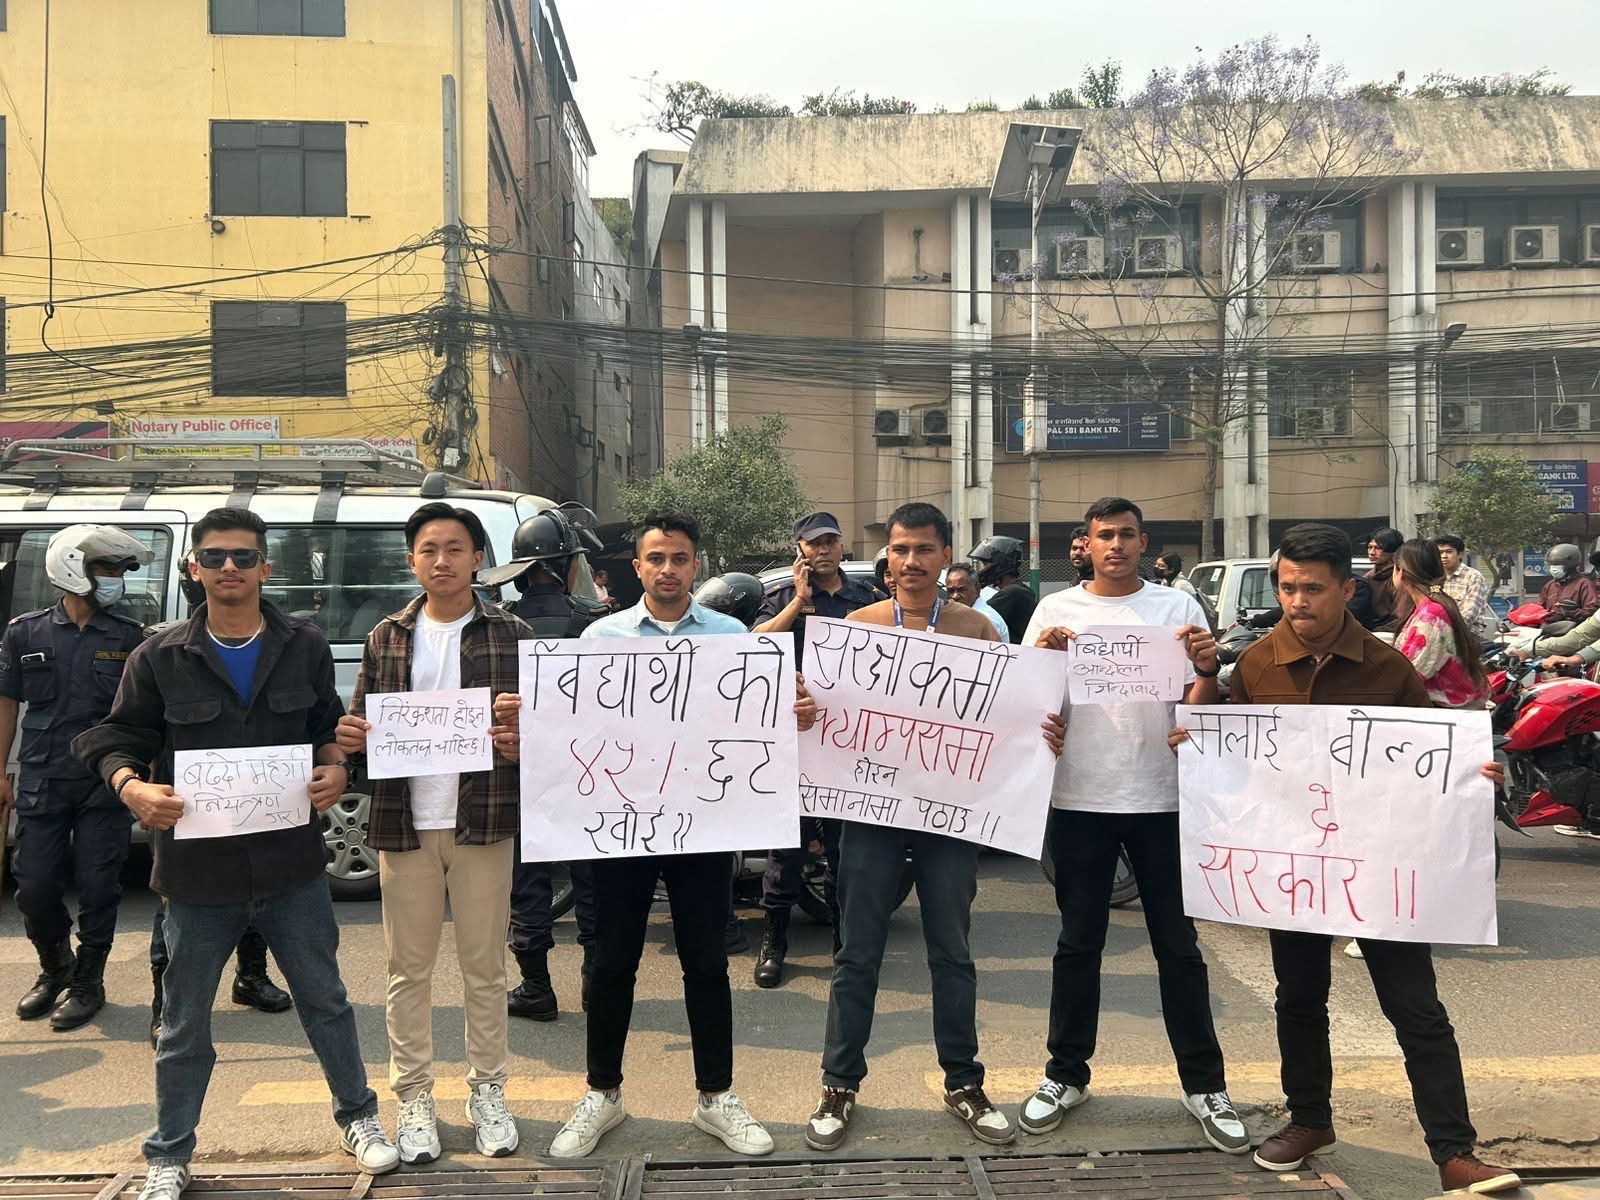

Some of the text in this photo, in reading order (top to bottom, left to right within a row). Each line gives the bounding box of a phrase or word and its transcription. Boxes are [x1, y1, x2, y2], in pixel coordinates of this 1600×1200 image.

[131, 418, 272, 434] Notary Public Office
[1047, 426, 1062, 434] PAL
[1064, 426, 1077, 434] SBI
[1079, 426, 1103, 434] BANK
[453, 699, 485, 729] होइन
[717, 636, 785, 728] को
[1185, 706, 1457, 795] मलाई बोल्न
[1308, 782, 1339, 848] दे
[1198, 843, 1365, 923] सरकार
